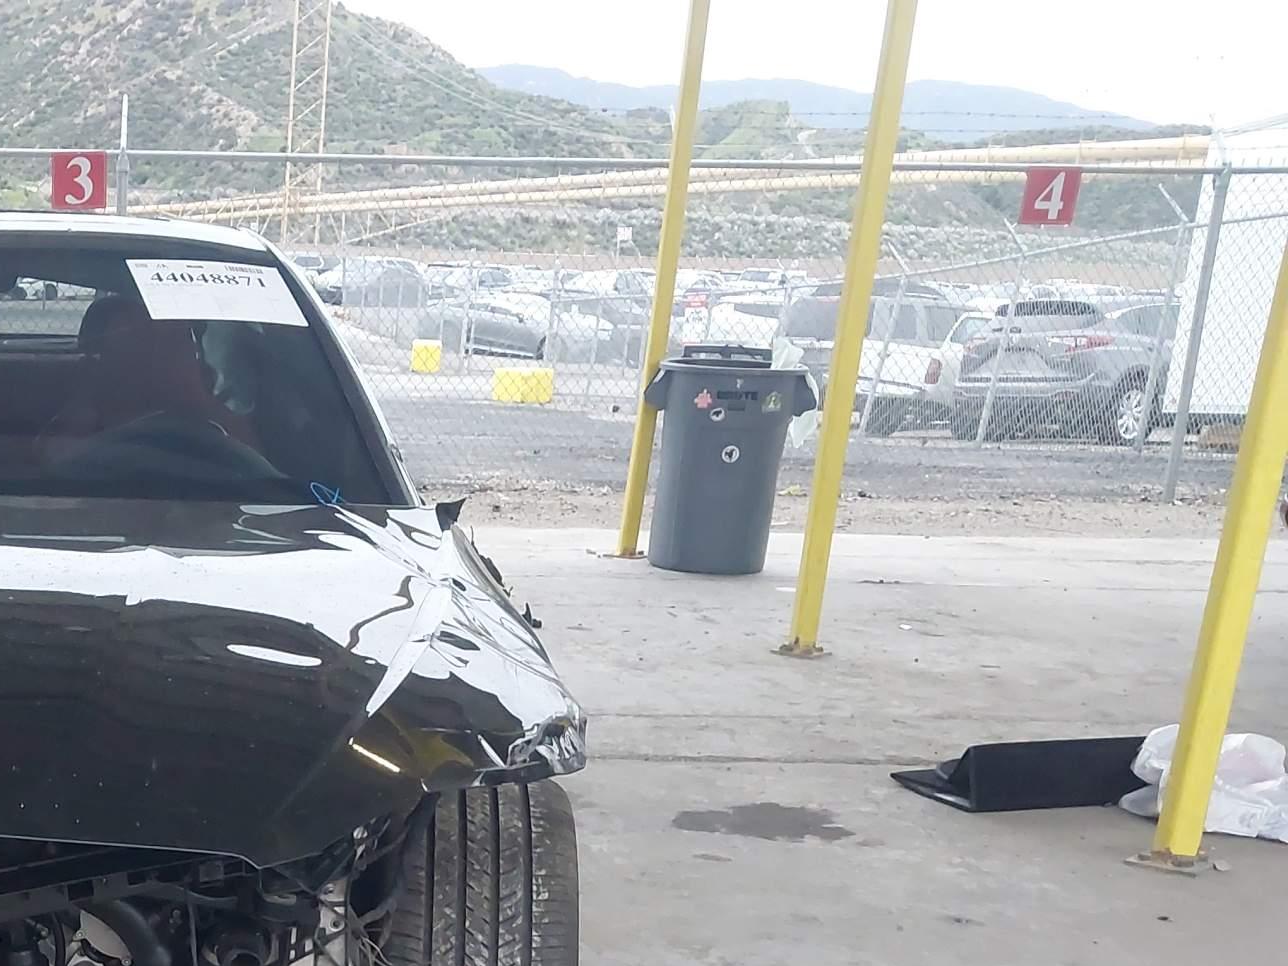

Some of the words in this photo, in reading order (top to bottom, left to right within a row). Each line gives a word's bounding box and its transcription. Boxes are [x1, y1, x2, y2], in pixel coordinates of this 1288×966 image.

[65, 156, 94, 205] 3
[1034, 171, 1066, 220] 4
[151, 272, 266, 288] 44048871
